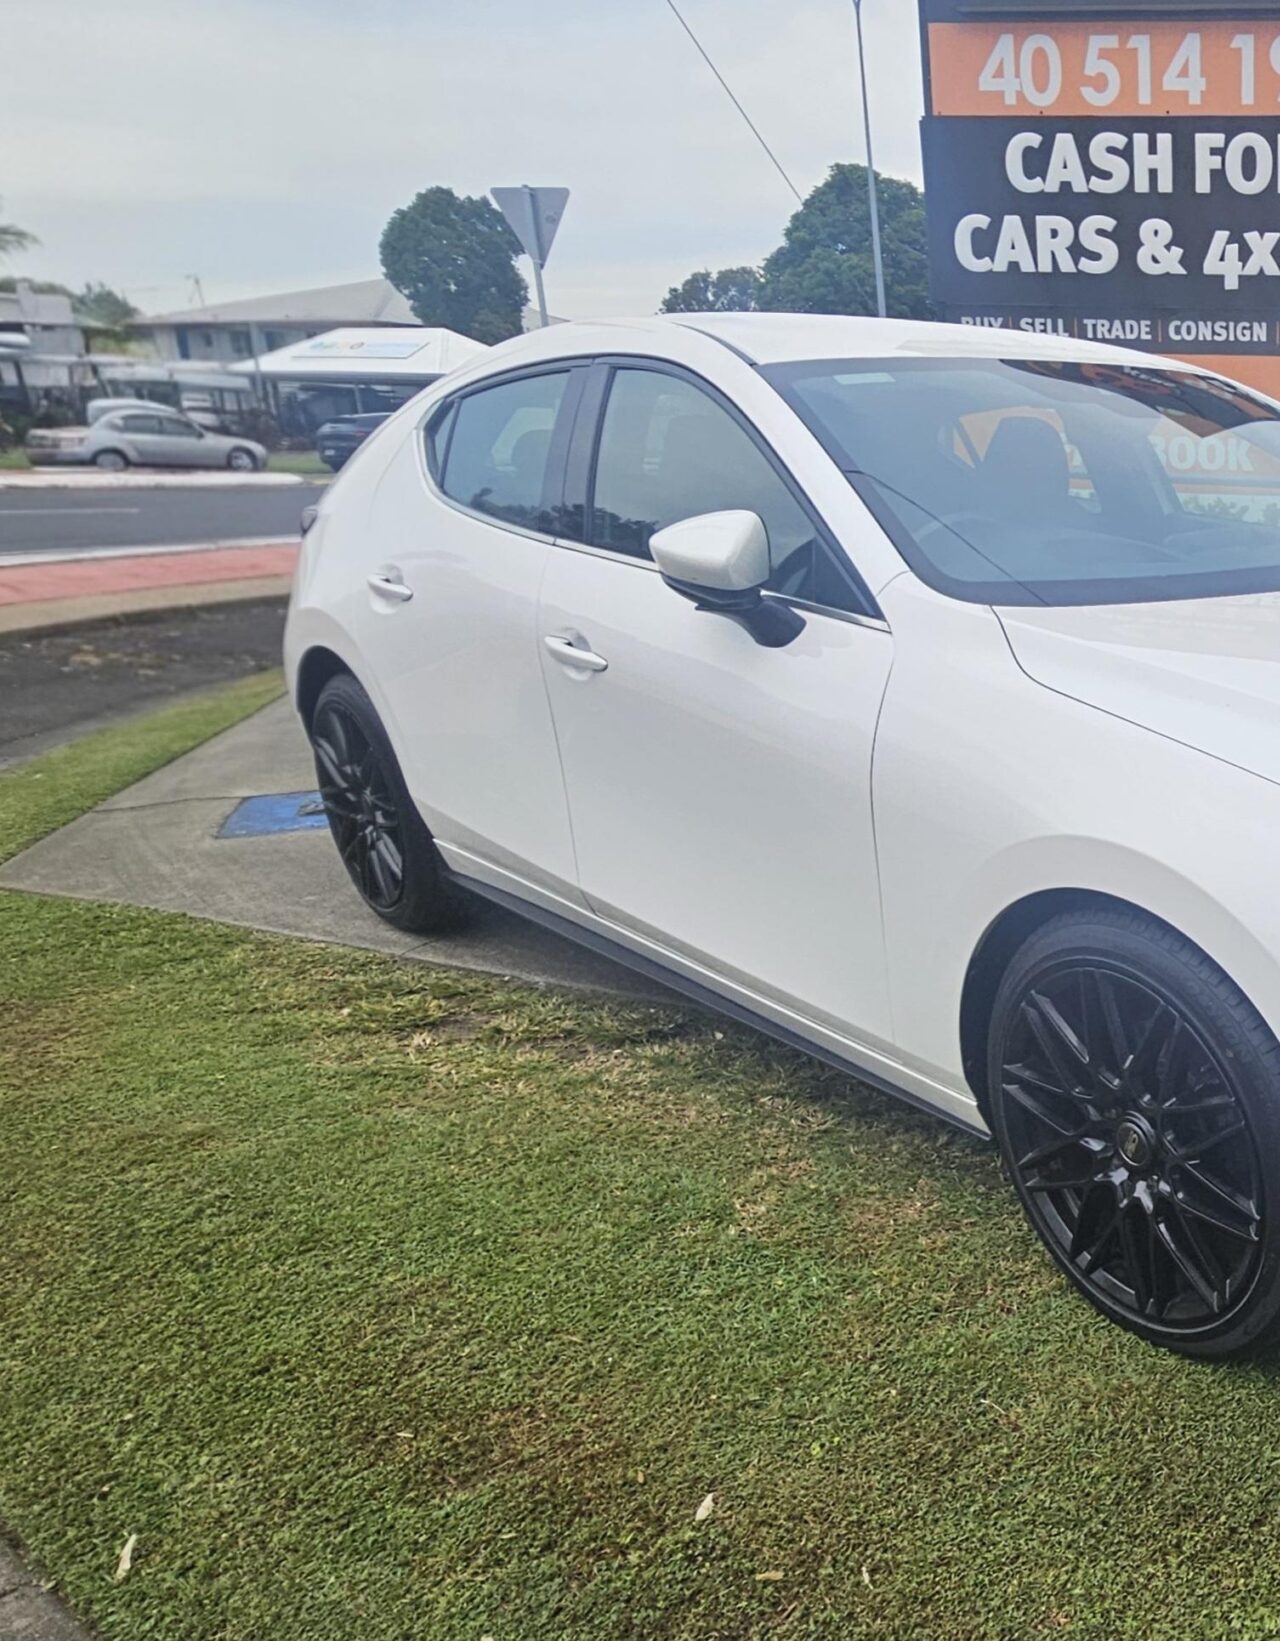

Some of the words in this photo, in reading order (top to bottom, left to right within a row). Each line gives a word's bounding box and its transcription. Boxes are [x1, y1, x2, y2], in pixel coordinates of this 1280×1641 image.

[978, 33, 1063, 107] 40
[1079, 32, 1206, 107] 514
[1004, 131, 1174, 194] CASH
[953, 213, 1119, 275] CARS
[1136, 217, 1188, 276] &
[1019, 317, 1070, 338] SELL
[1083, 319, 1152, 340] TRADE
[1167, 320, 1267, 342] CONSIGN
